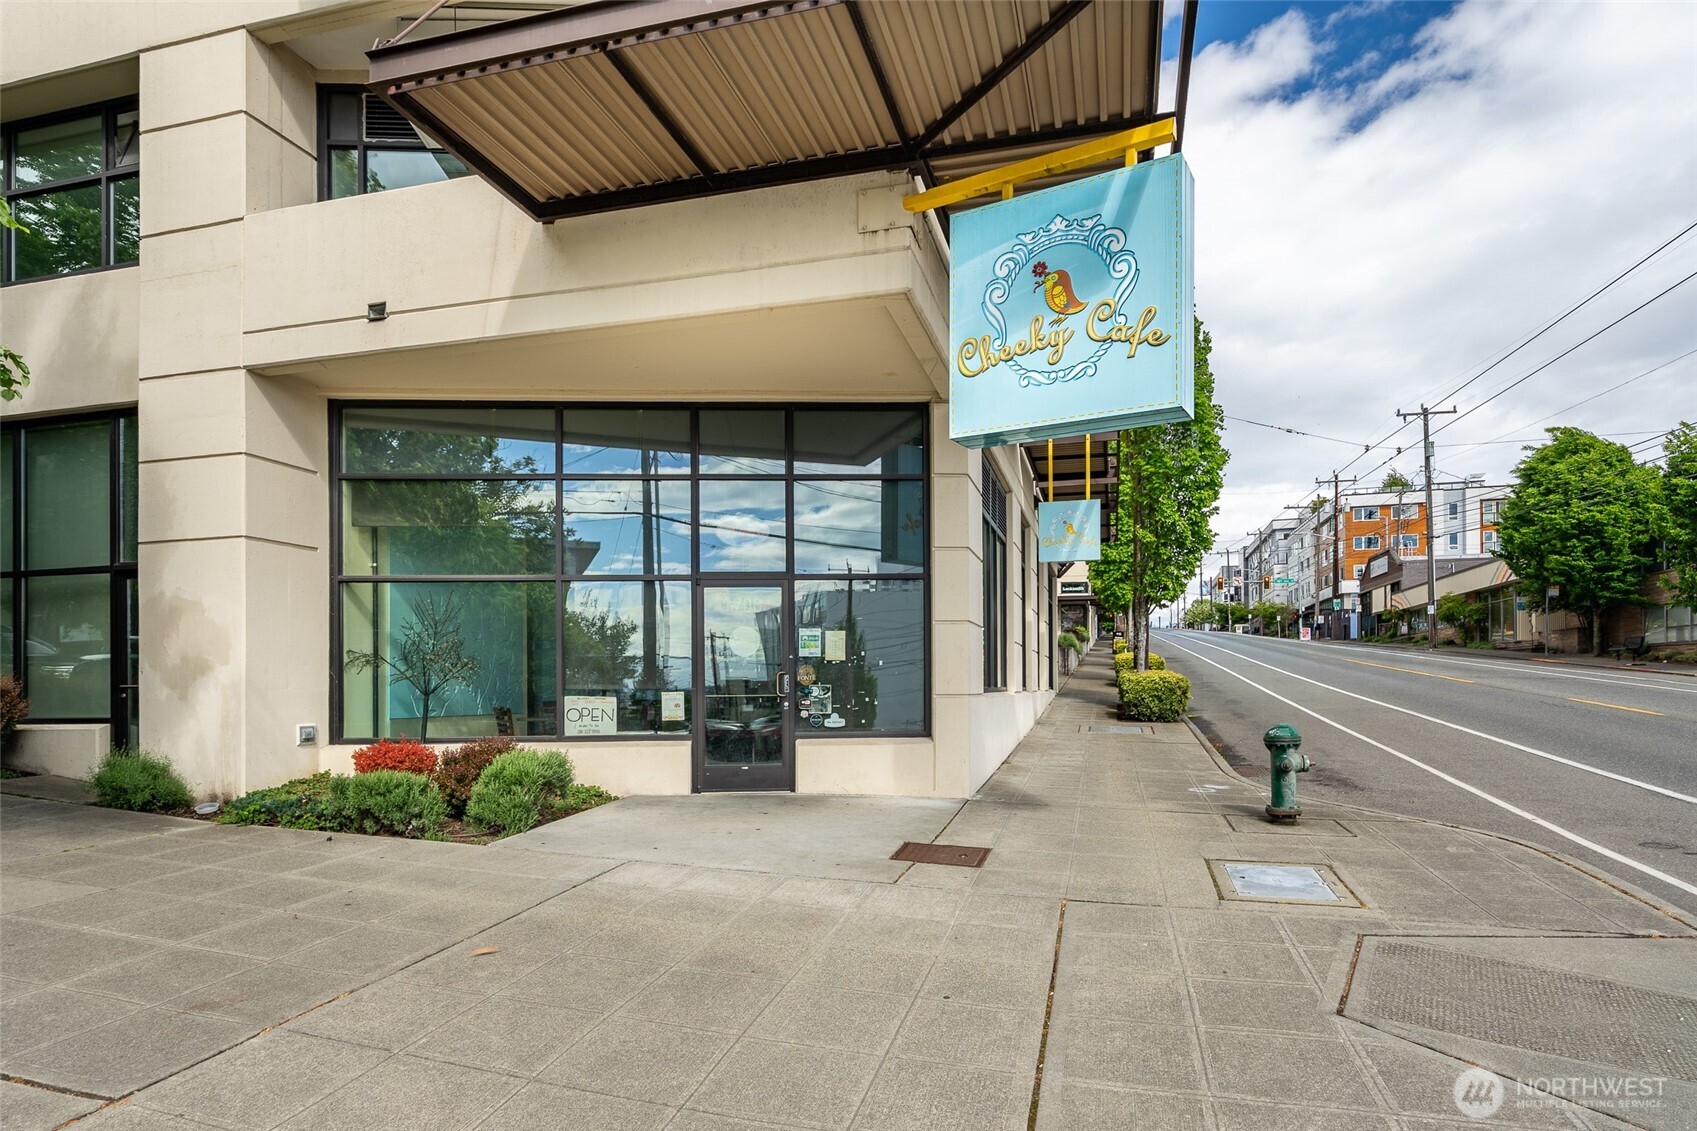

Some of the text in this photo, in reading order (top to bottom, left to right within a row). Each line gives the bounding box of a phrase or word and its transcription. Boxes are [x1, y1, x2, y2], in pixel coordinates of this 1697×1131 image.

[958, 299, 1171, 378] Cheeky Cafe
[566, 707, 615, 722] OPEN
